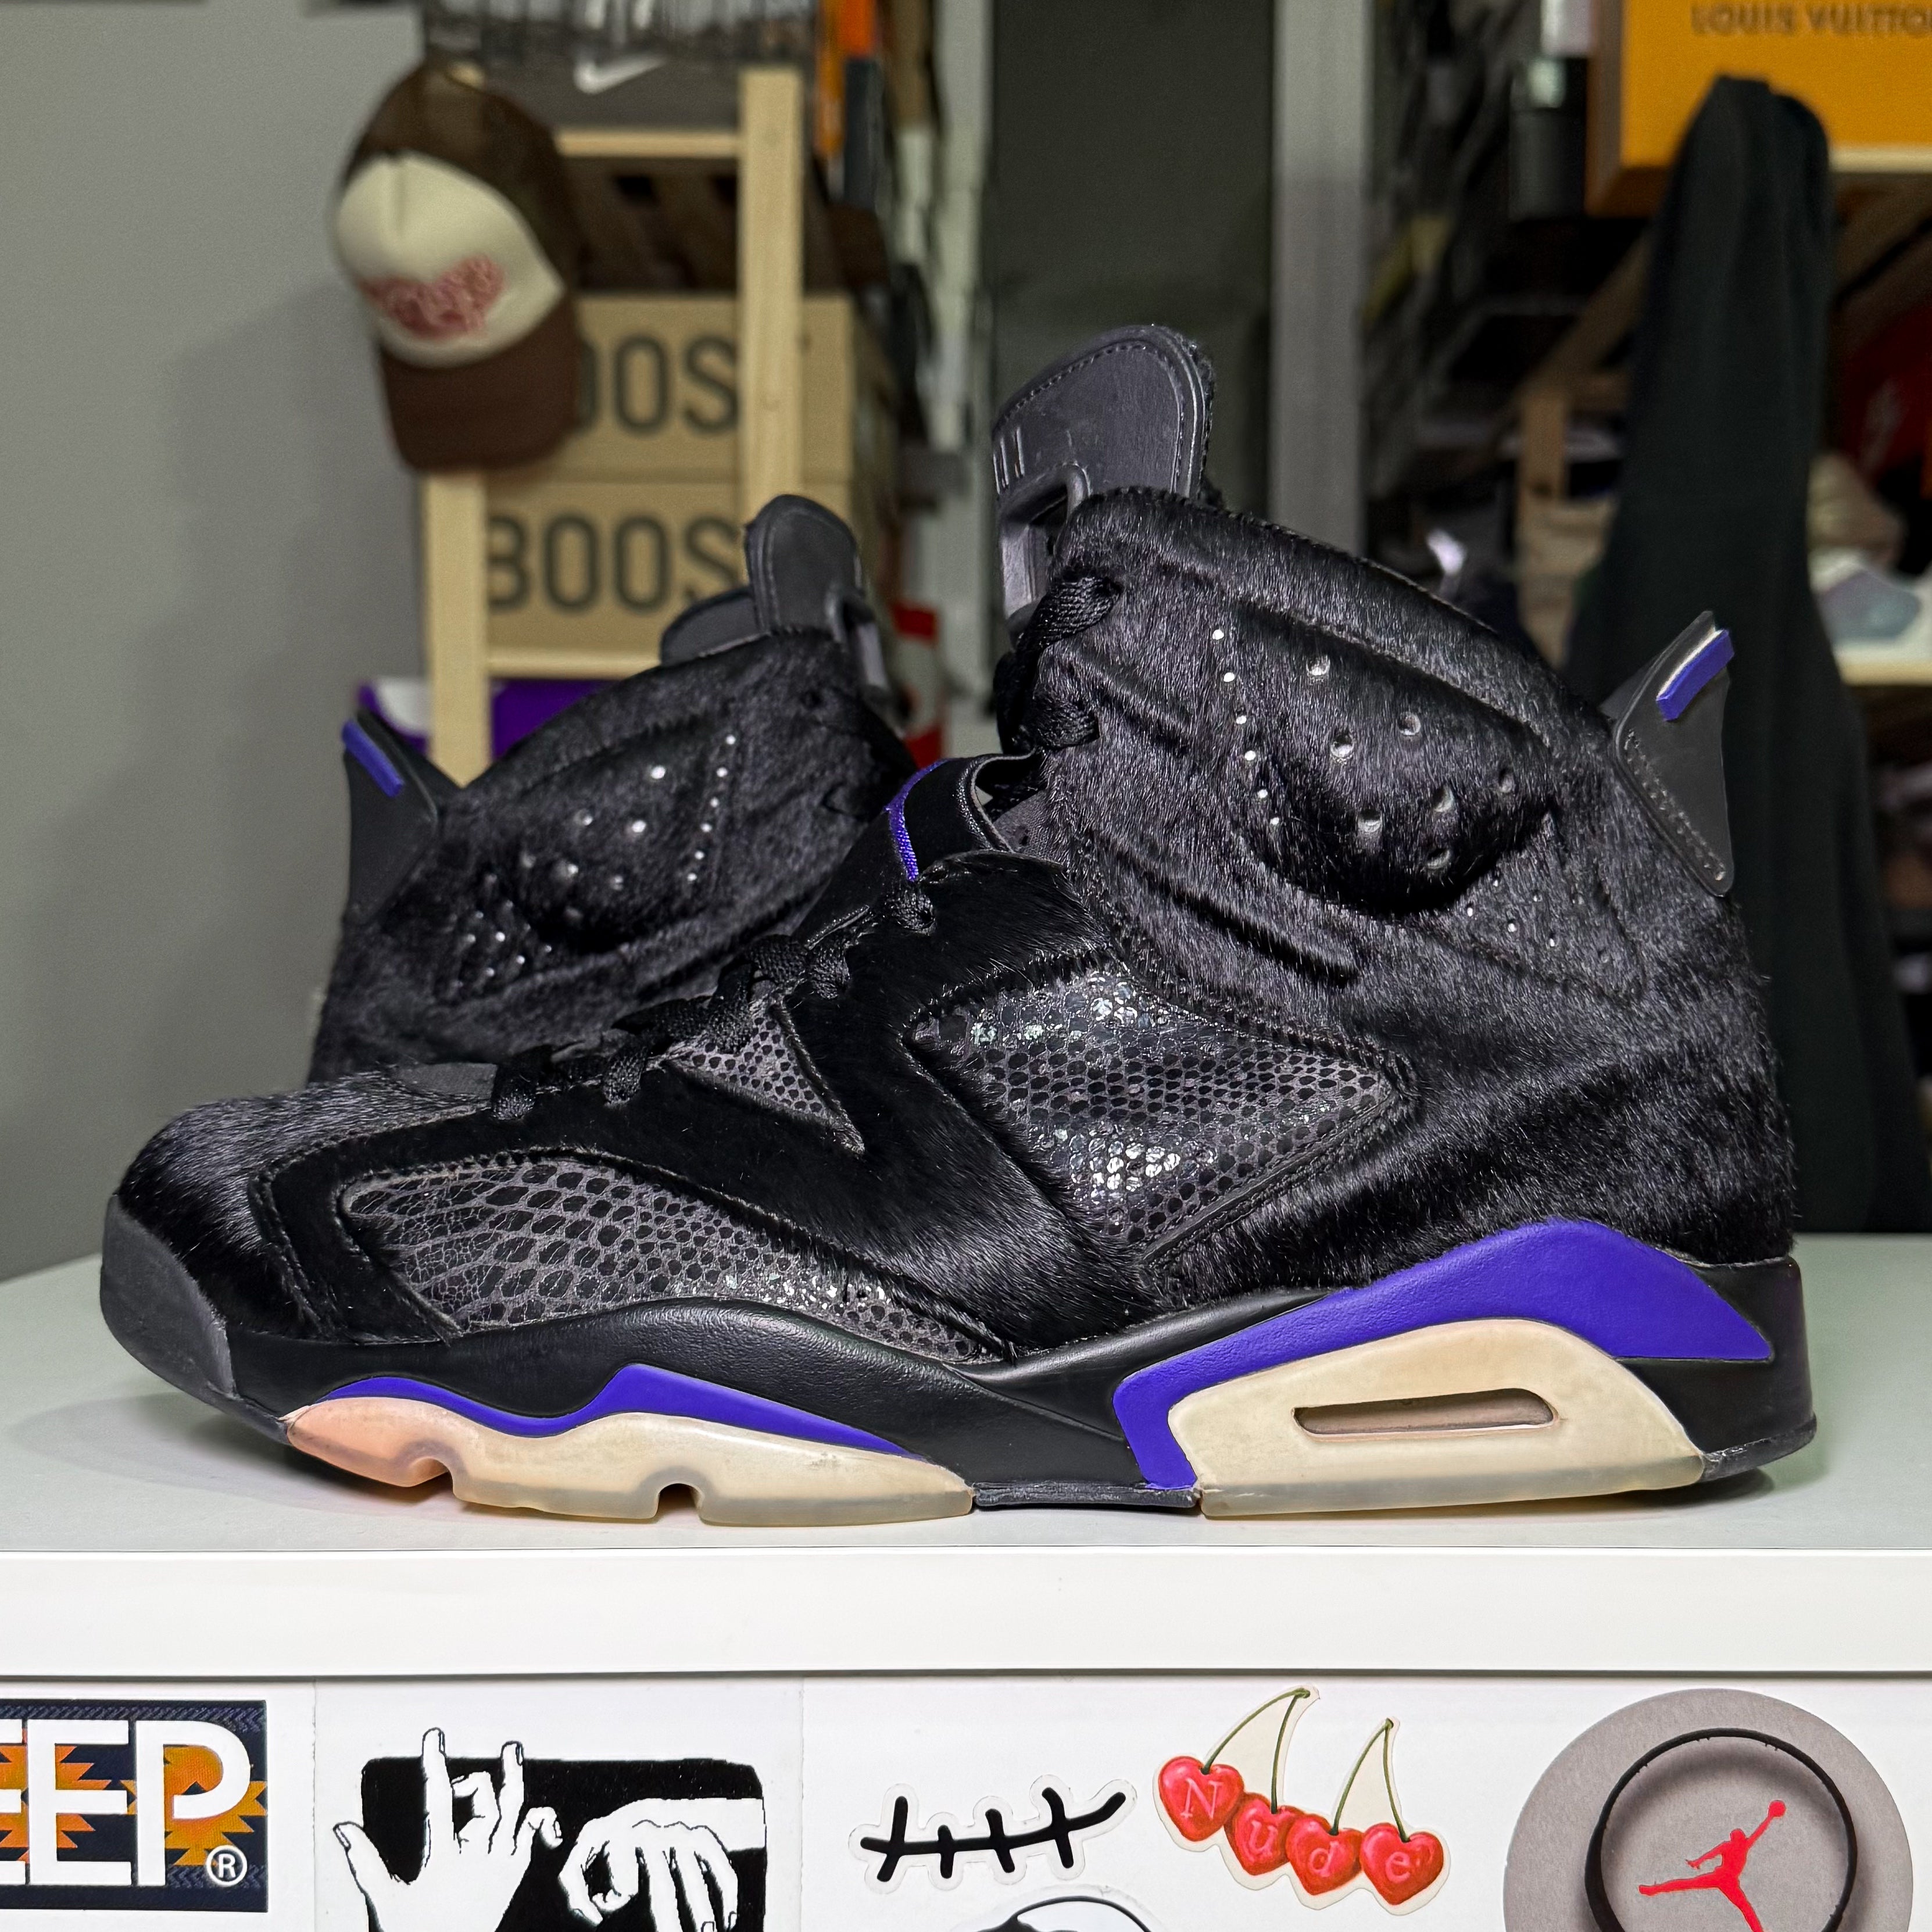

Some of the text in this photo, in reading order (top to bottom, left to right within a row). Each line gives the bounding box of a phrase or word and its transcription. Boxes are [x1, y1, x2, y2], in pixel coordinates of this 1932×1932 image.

[1805, 2, 1932, 37] VUITTO
[0, 1719, 251, 1886] EP
[1180, 1779, 1411, 1883] Nude
